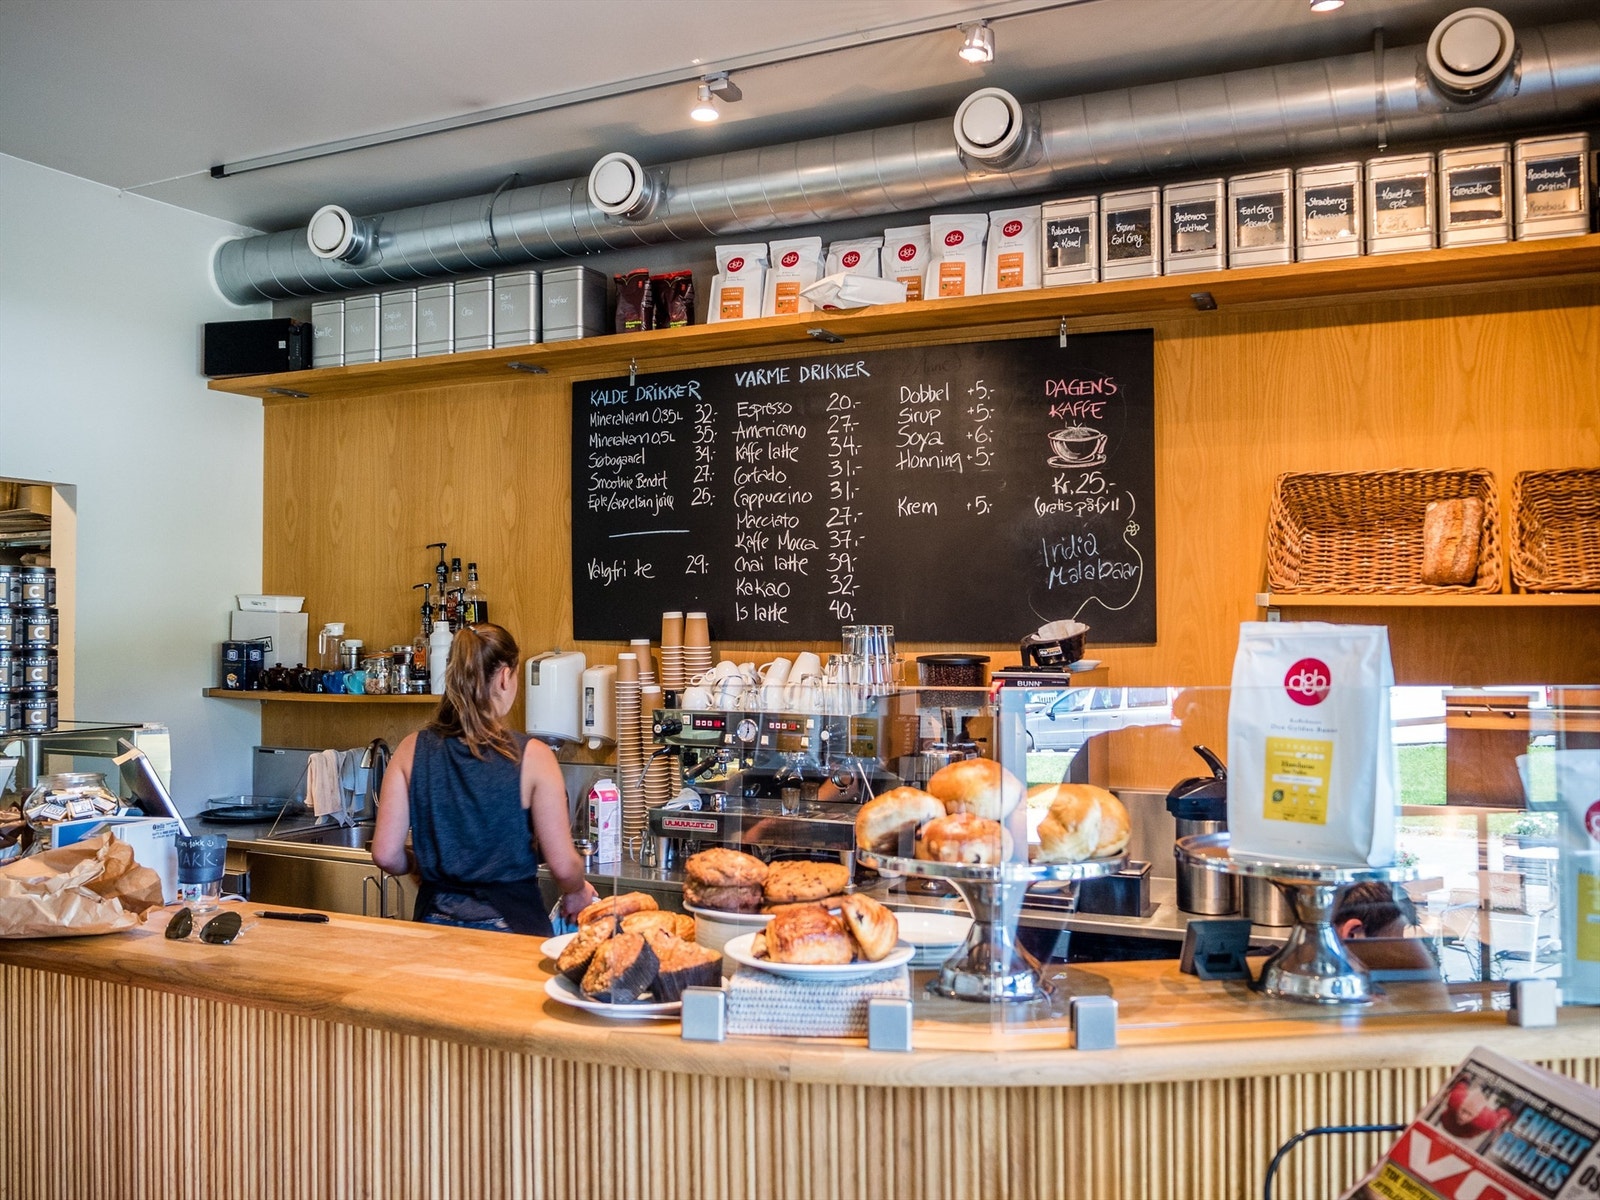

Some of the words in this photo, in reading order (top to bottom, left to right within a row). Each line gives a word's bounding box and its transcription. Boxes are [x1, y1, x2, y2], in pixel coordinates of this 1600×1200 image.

[1240, 206, 1256, 215] Earl
[1256, 204, 1274, 220] Grey
[1111, 234, 1126, 245] Earl
[1126, 232, 1144, 248] Grey
[735, 366, 790, 388] VARME
[799, 360, 871, 384] DRIKKER
[590, 389, 629, 407] KALDE
[899, 382, 949, 404] Dobbel
[1045, 376, 1118, 398] DAGENS
[589, 410, 649, 427] Mineralvann
[737, 401, 793, 421] Espresso
[897, 407, 941, 426] Sirup
[1048, 400, 1107, 420] KAFFE
[731, 420, 807, 442] Americano
[896, 424, 944, 452] Soya
[735, 441, 763, 463] Kaffe
[768, 441, 799, 463] latte
[896, 448, 963, 474] Honning
[587, 472, 633, 491] Smoothie
[734, 465, 787, 486] Cortado
[733, 485, 813, 511] Cappuccino
[898, 496, 938, 517] Krem
[736, 509, 800, 530] Macciato
[735, 531, 770, 553] Kaffe
[778, 529, 820, 551] Mocca
[587, 557, 627, 586] Valgfri
[633, 558, 656, 579] te
[734, 555, 764, 573] Chai
[774, 553, 809, 576] latte
[1048, 558, 1140, 590] Malabaar
[735, 577, 791, 598] Kakao
[735, 601, 749, 622] Is
[754, 602, 789, 624] latte
[1512, 1107, 1592, 1165] ENKELT
[1492, 1130, 1572, 1192] GRATIS
